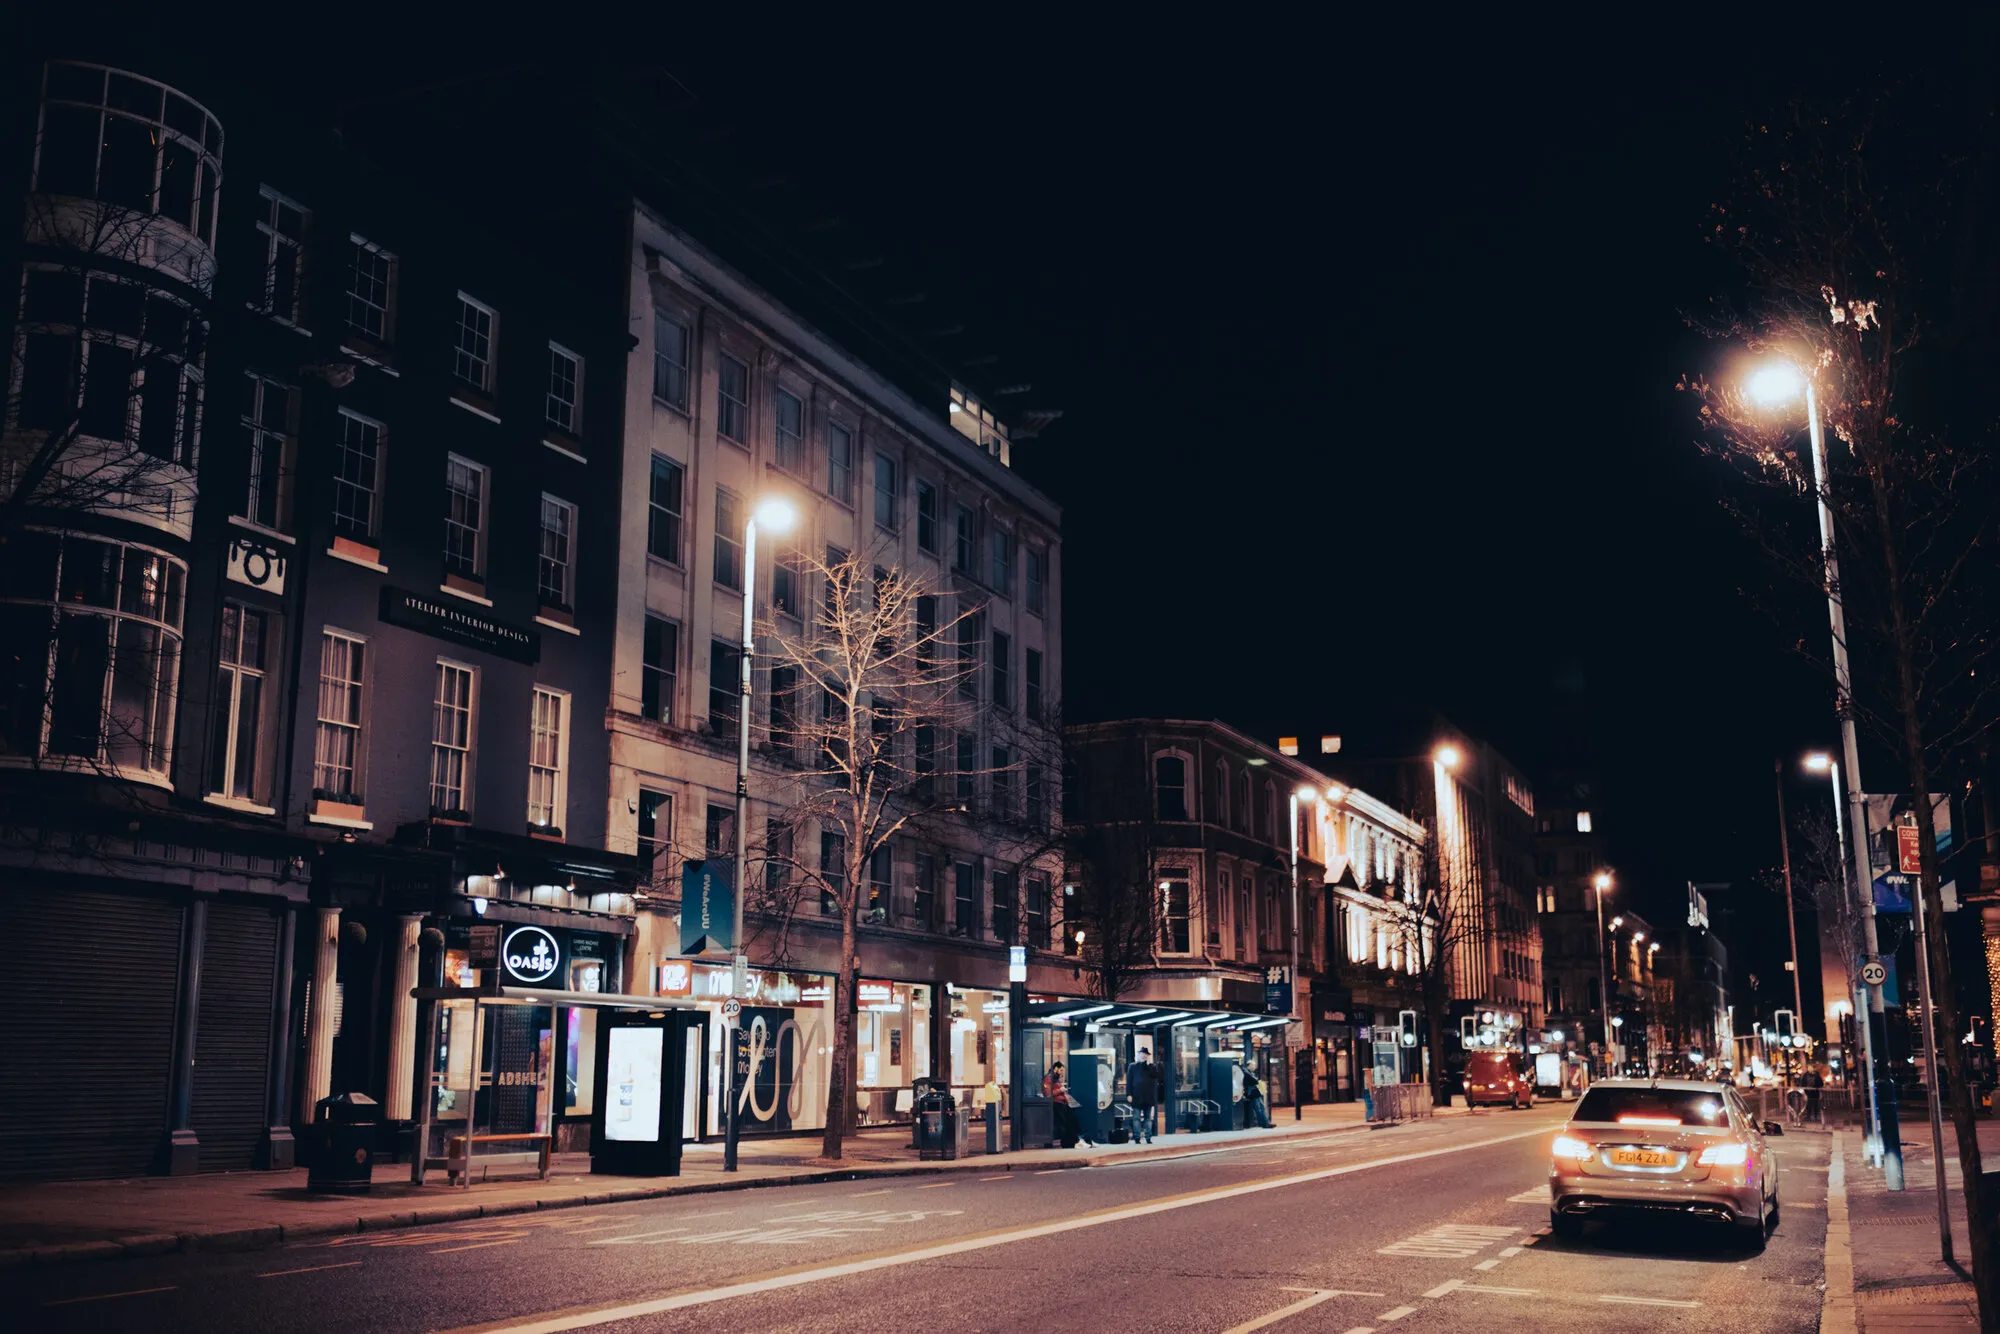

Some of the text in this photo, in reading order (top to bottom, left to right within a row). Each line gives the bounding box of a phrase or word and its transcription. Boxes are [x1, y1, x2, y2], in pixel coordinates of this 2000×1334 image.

[405, 597, 530, 644] ATELIER INTERIOR DESIGN
[702, 873, 711, 929] #WeAreUU
[509, 947, 553, 971] OASIS
[1267, 966, 1290, 984] #1
[1865, 968, 1884, 979] 20
[726, 1003, 739, 1012] 20
[1618, 1151, 1667, 1164] FG14 ZZA
